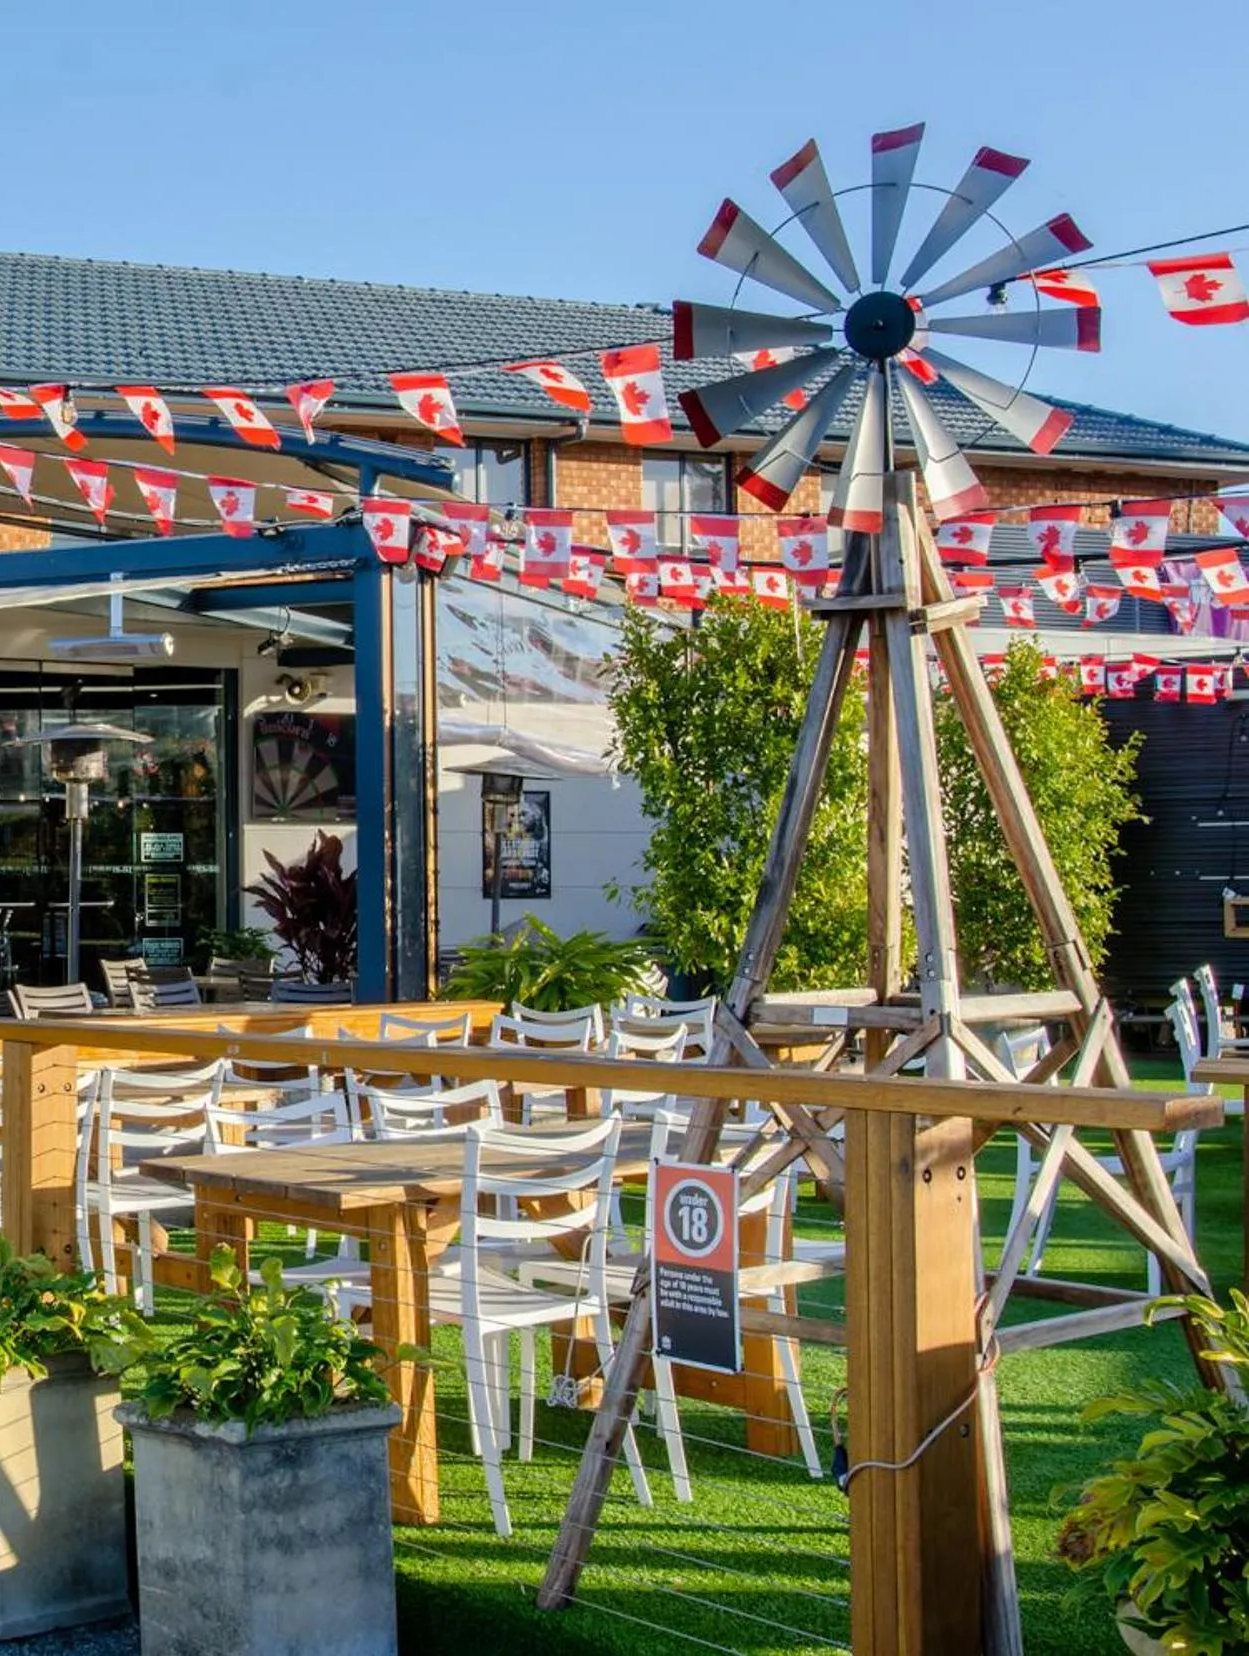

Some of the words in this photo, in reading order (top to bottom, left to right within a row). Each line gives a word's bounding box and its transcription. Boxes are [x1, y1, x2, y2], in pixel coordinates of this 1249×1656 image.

[679, 1193, 708, 1207] under
[678, 1206, 708, 1243] 18
[683, 1272, 701, 1282] under
[701, 1275, 713, 1285] the
[660, 1279, 671, 1289] age
[687, 1284, 703, 1293] years
[703, 1286, 720, 1296] must
[668, 1289, 682, 1299] with
[682, 1302, 694, 1312] this
[693, 1305, 708, 1315] area
